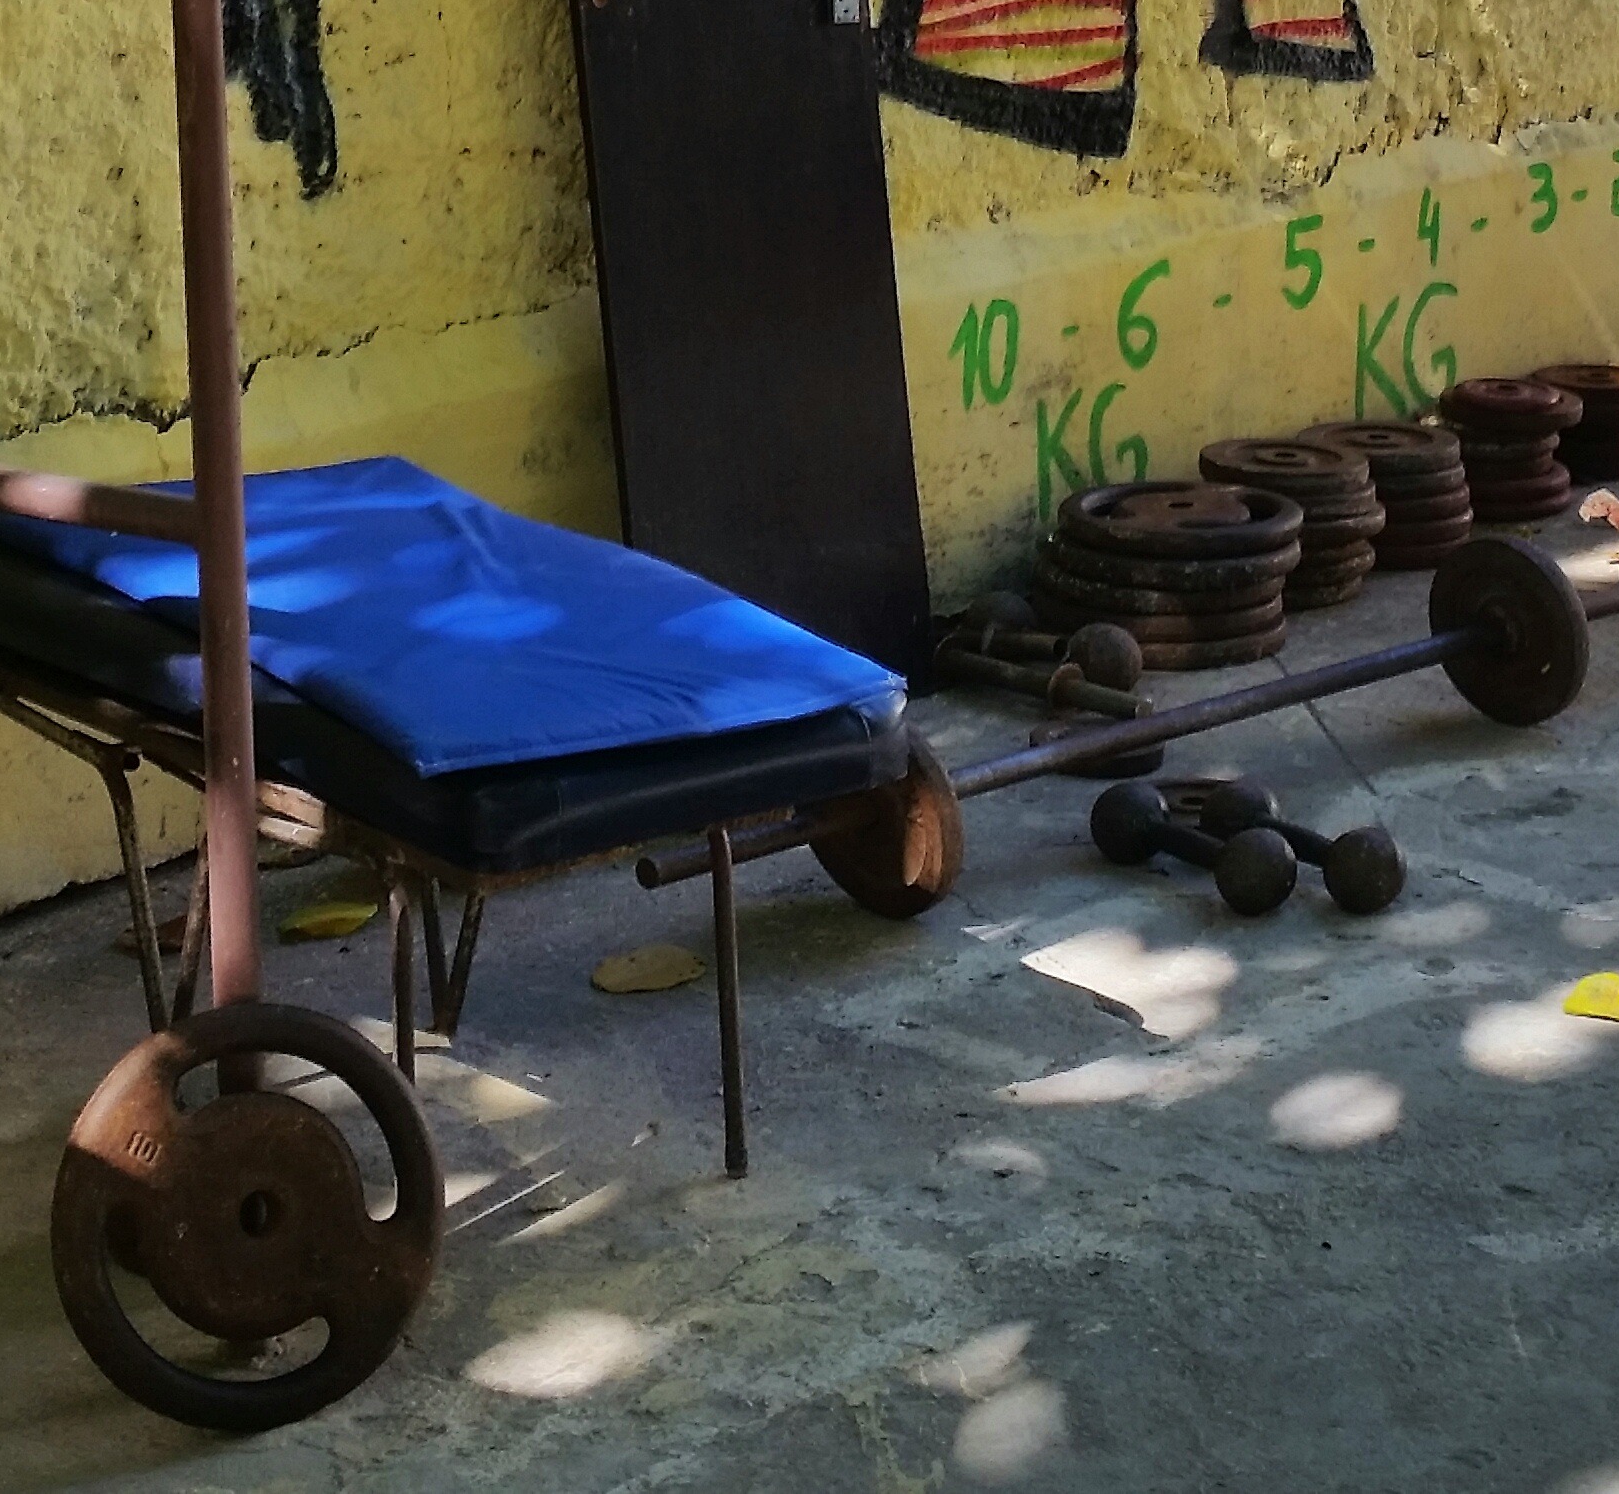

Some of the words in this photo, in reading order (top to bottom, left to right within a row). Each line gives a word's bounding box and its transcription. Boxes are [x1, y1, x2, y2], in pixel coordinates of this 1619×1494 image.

[948, 298, 1019, 408] 10
[1117, 259, 1171, 369] 6
[1281, 214, 1324, 309] 5
[1414, 187, 1442, 267] 4
[1527, 161, 1558, 234] 3
[1354, 282, 1458, 420] KG
[1034, 383, 1149, 523] KG
